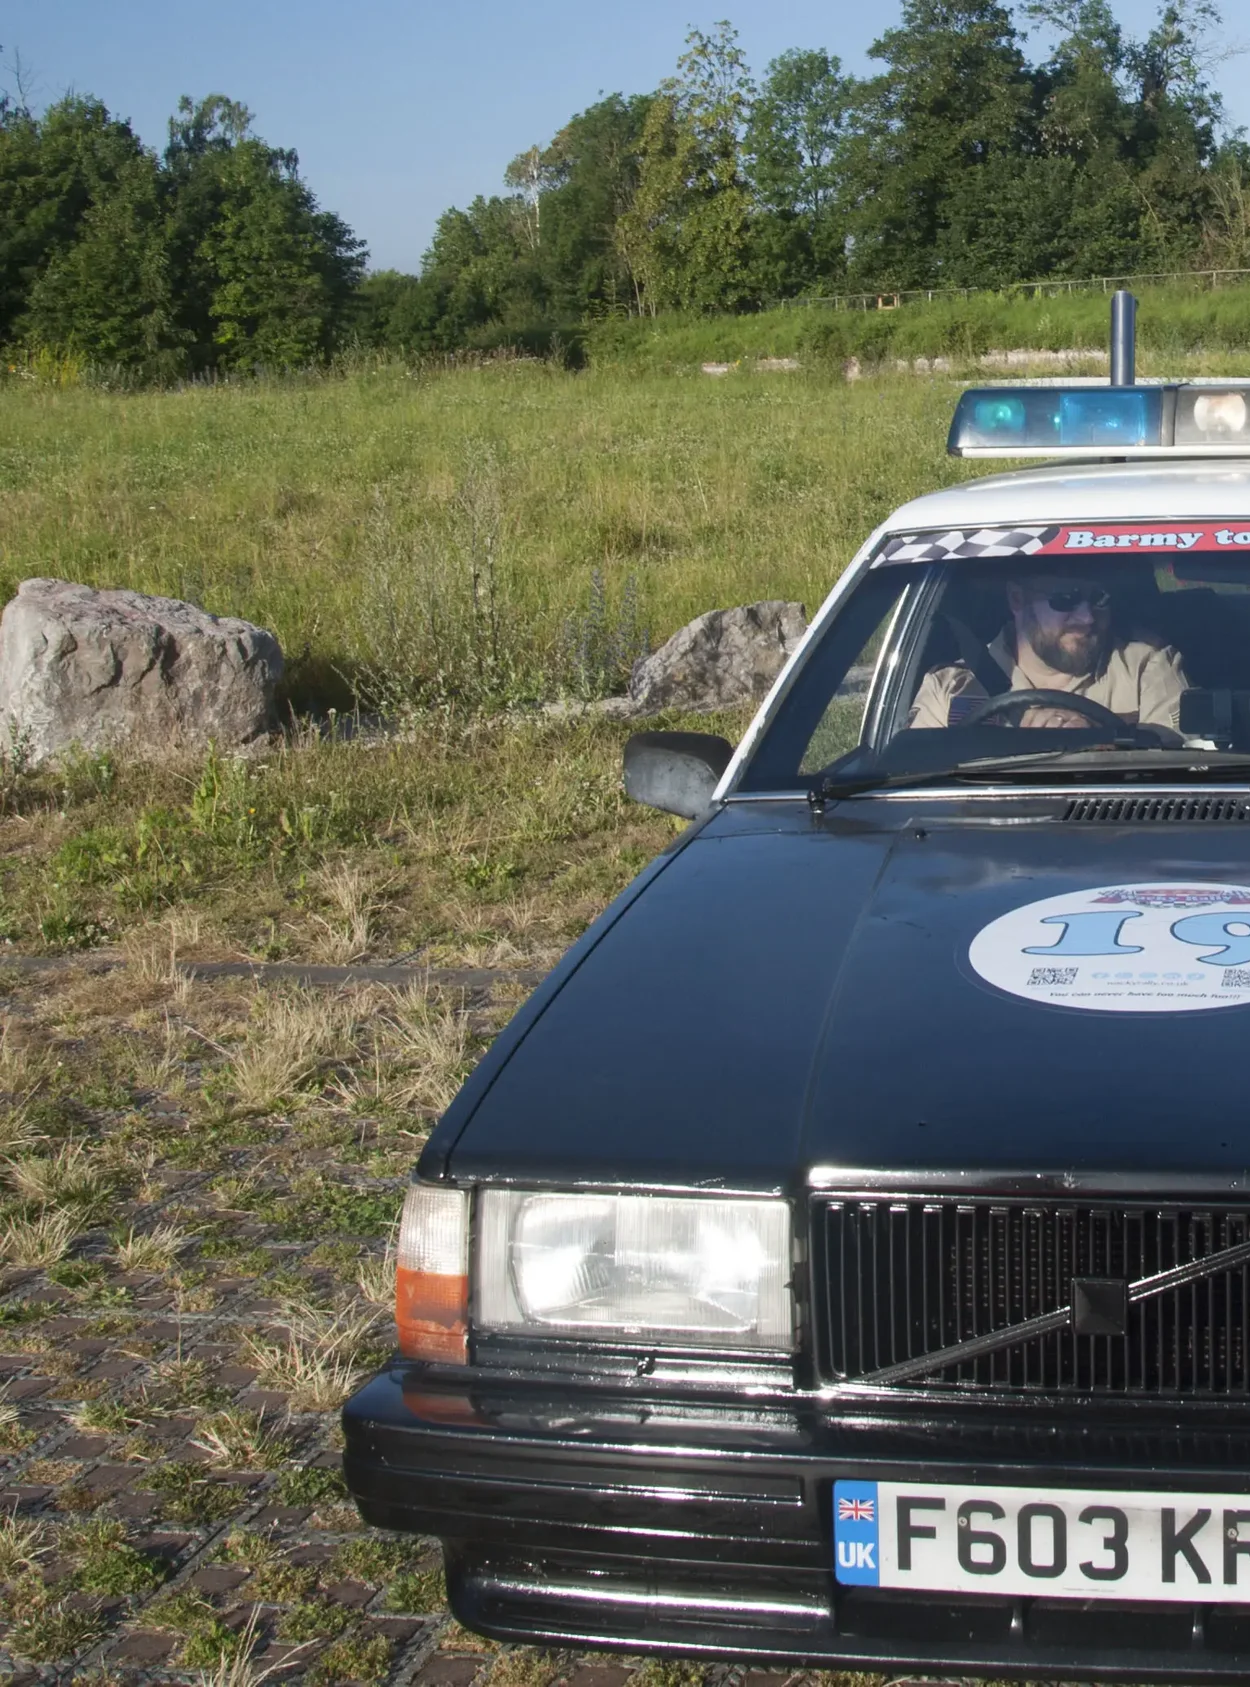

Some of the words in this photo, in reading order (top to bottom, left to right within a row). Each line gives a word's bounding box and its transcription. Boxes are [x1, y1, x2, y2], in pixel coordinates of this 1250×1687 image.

[1063, 530, 1204, 549] Barmy
[896, 1494, 1130, 1582] F603
[838, 1541, 876, 1569] UK
